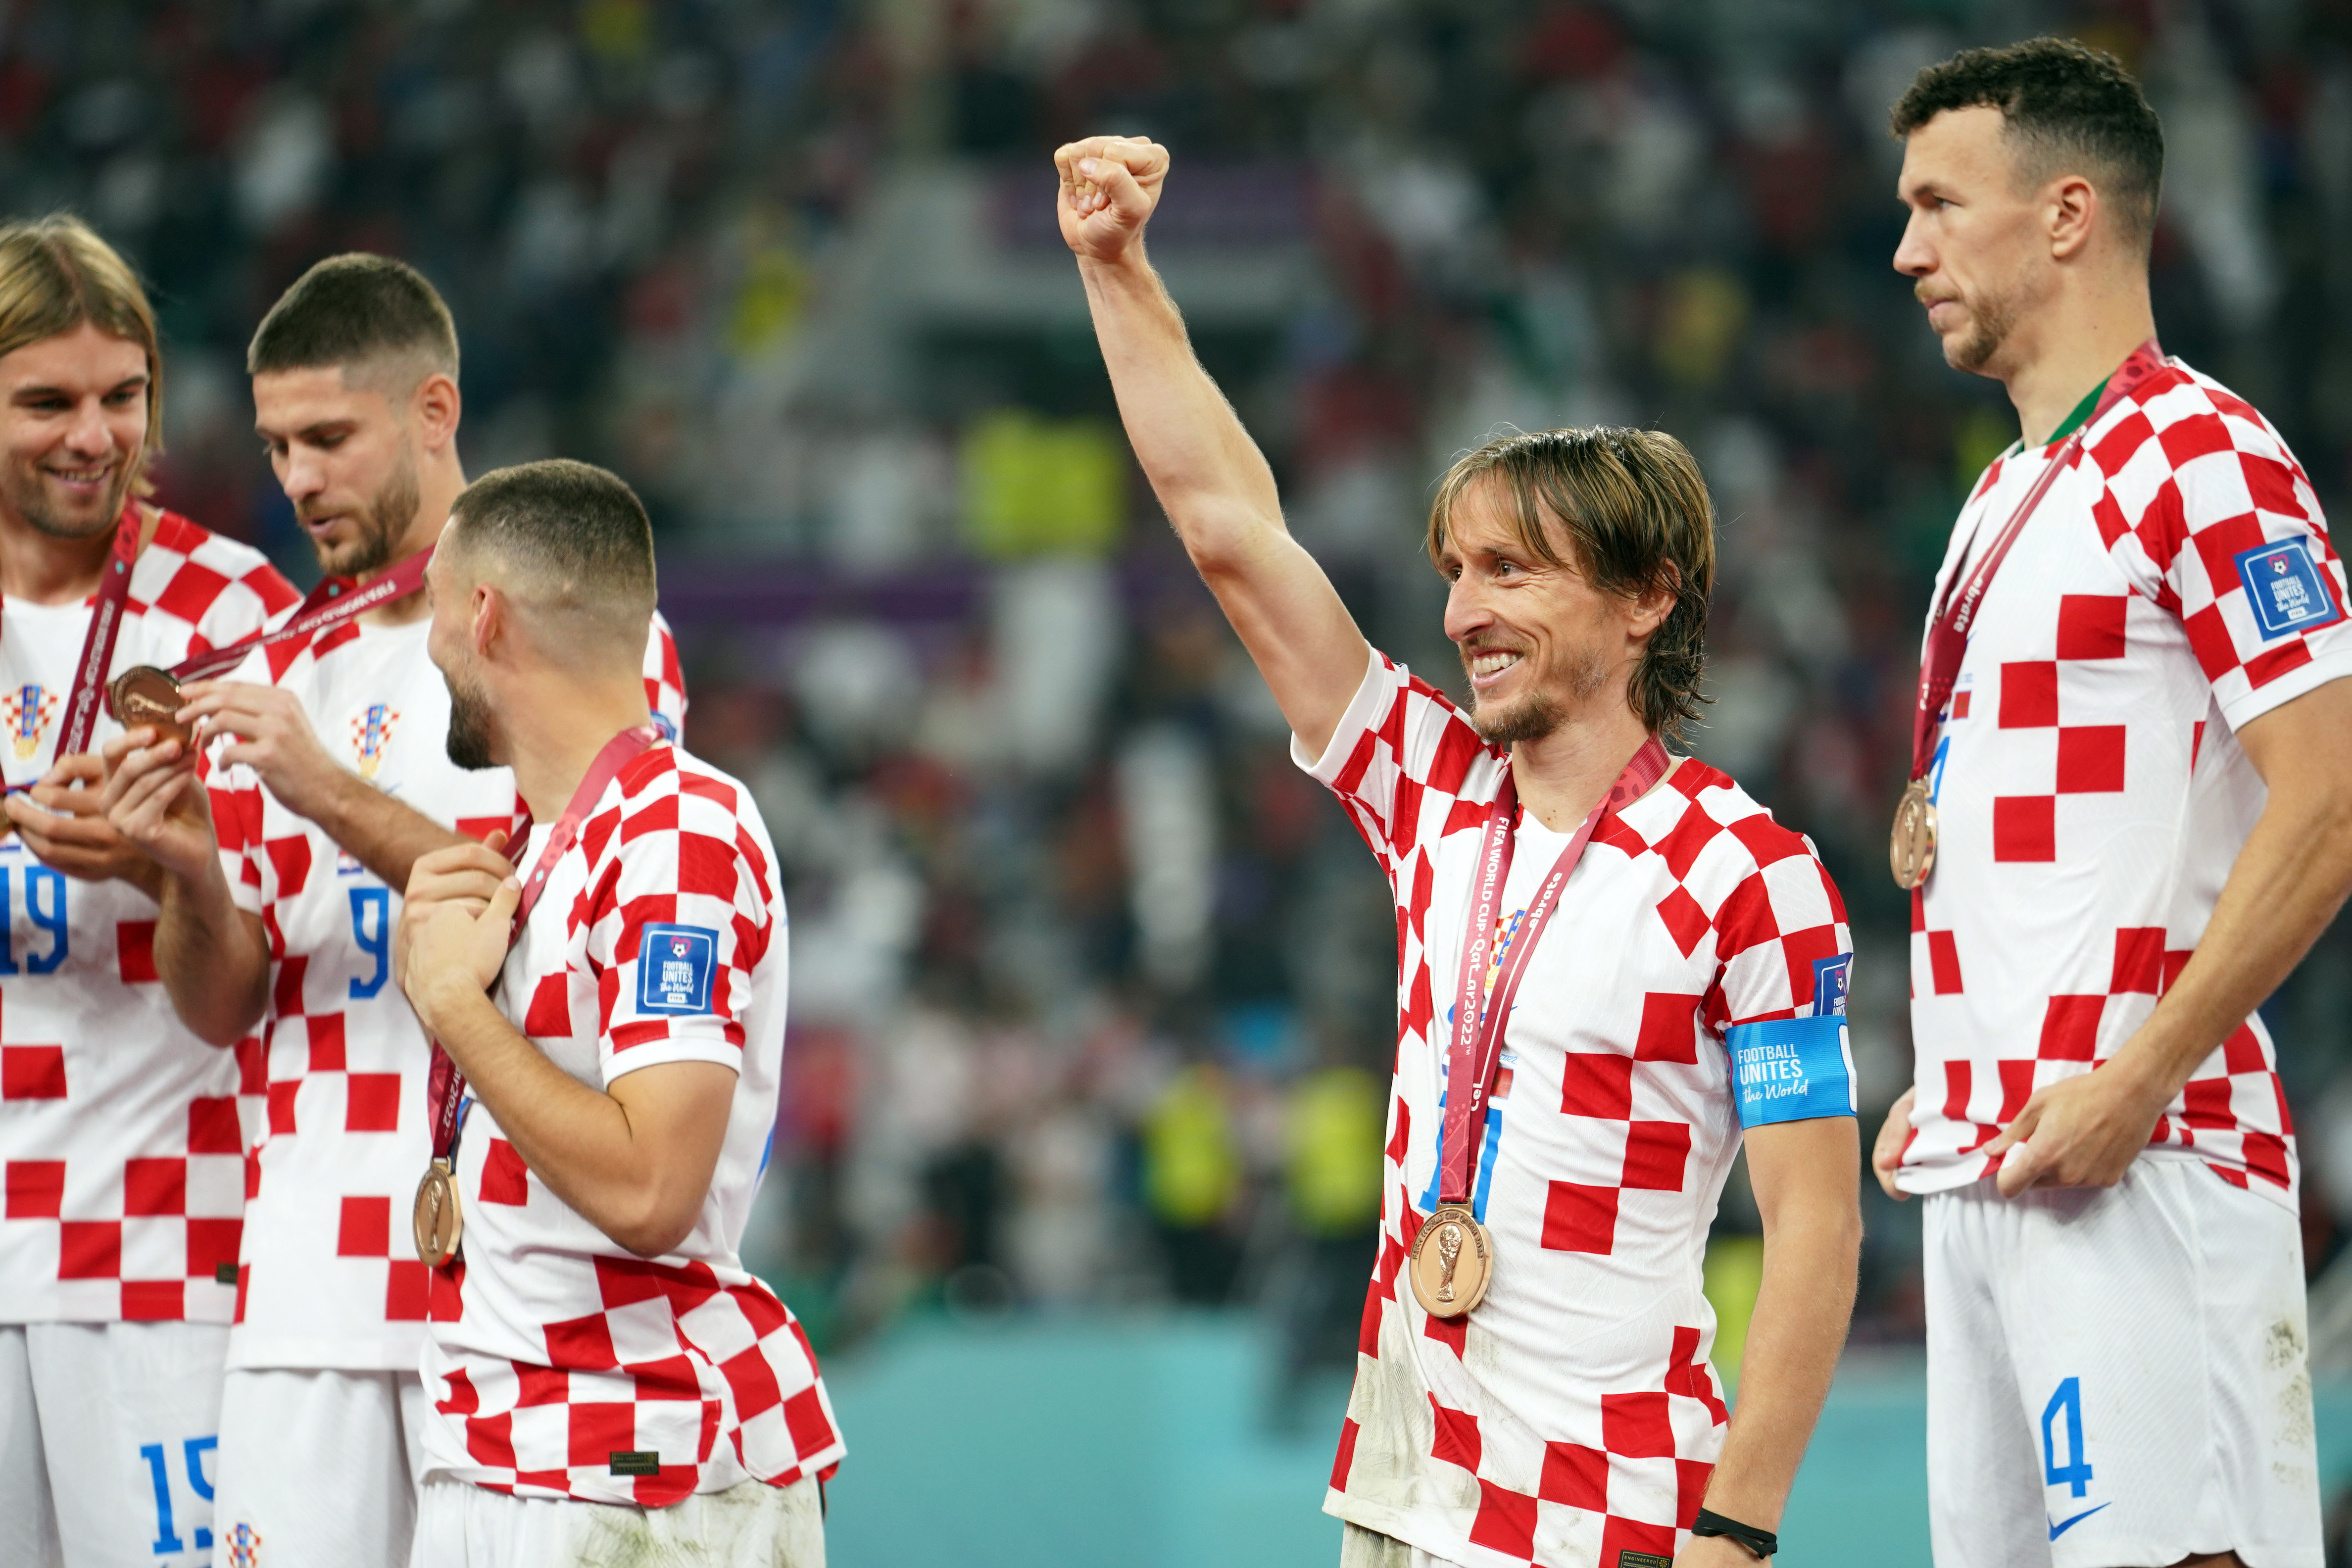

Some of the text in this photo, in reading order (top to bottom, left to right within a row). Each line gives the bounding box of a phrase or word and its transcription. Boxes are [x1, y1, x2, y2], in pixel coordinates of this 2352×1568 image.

[1492, 817, 1510, 847] FIFA
[1481, 848, 1502, 901] WORLD
[1476, 903, 1490, 931] CUP
[349, 888, 389, 999] 9
[662, 969, 692, 983] UNITES
[663, 960, 692, 971] FOOTBALL
[1738, 1044, 1798, 1064] FOOTBALL
[1739, 1059, 1803, 1085] UNITES
[1742, 1078, 1809, 1104] the World
[1421, 1214, 1444, 1236] WORLD
[1460, 1215, 1477, 1236] QATAR
[2041, 1377, 2092, 1497] 4
[1624, 1556, 1656, 1564] ENGINEERED
